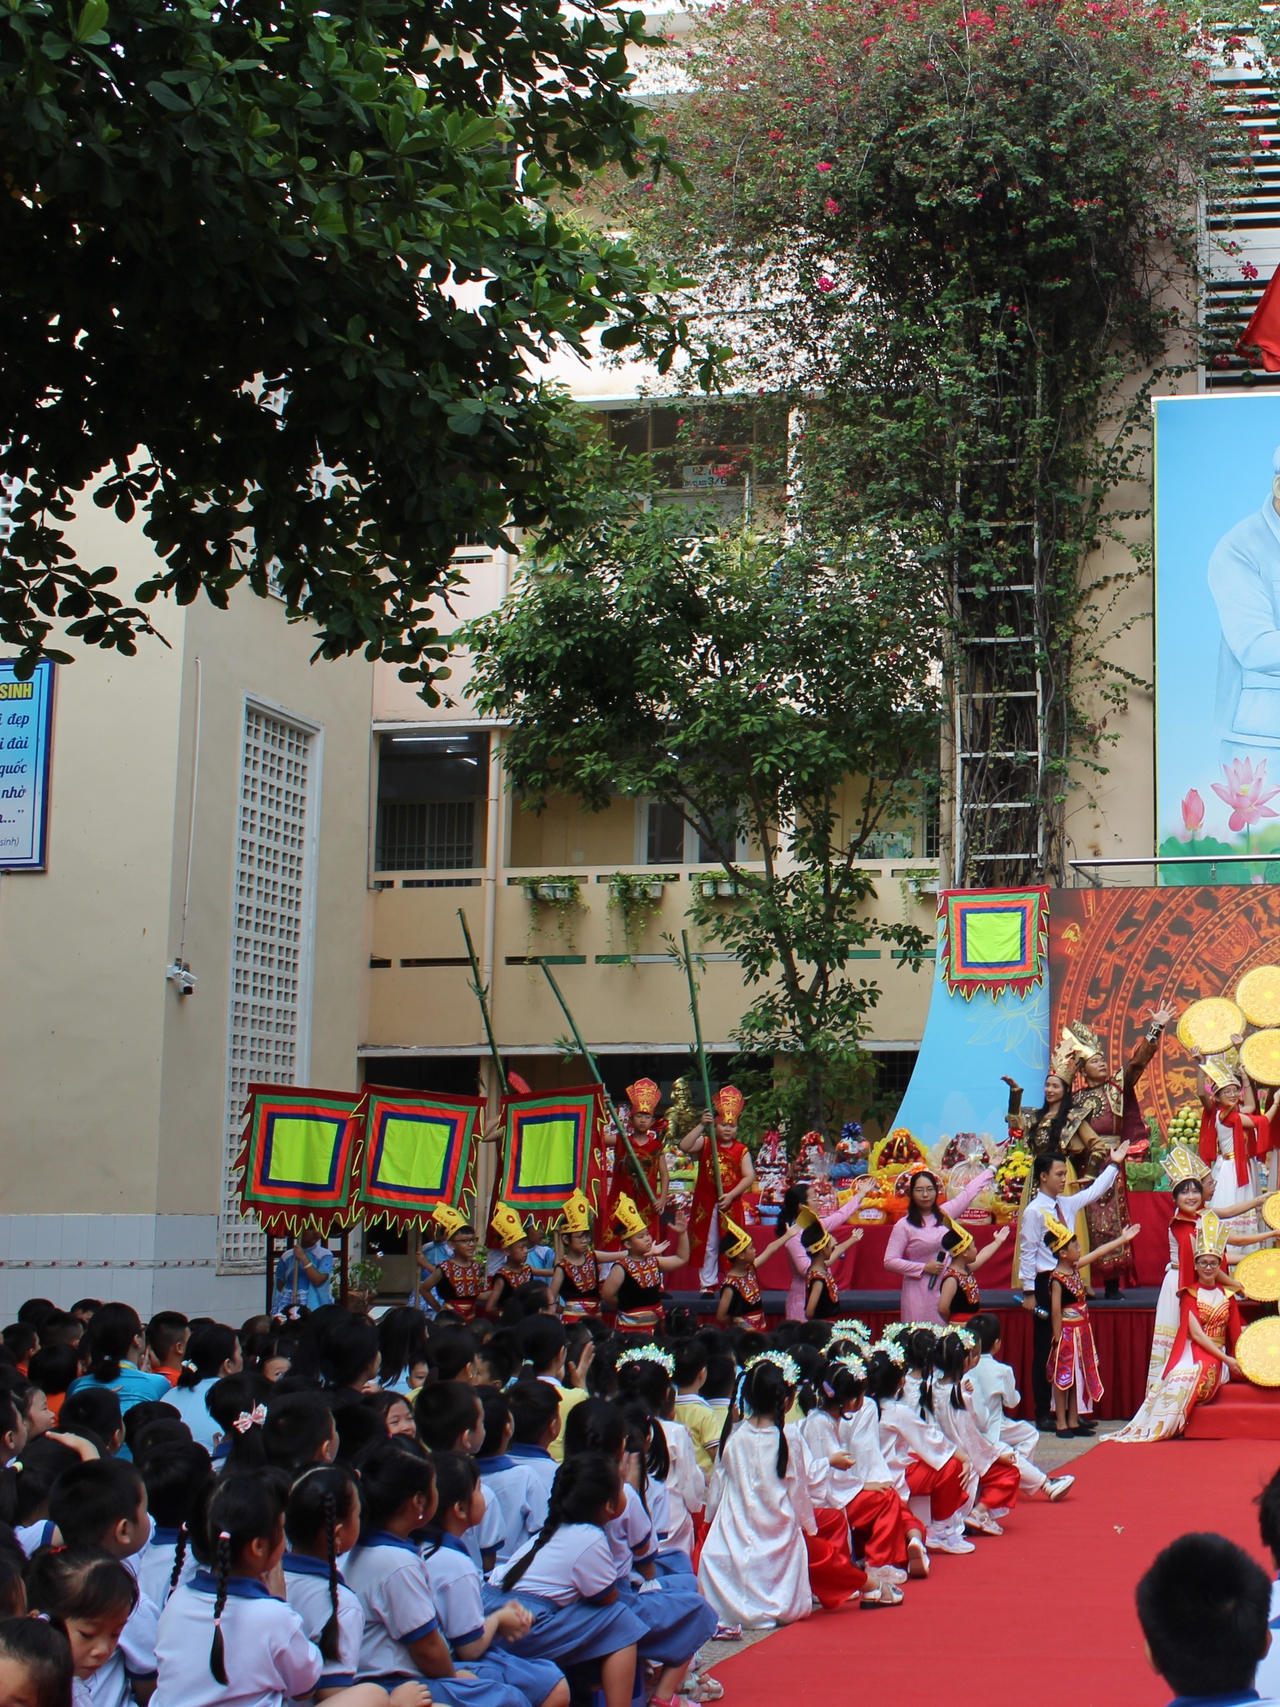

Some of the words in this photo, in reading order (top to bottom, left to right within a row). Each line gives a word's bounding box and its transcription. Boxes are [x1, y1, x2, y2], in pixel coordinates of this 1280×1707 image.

[0, 683, 32, 699] SINH
[7, 712, 30, 727] đẹp
[7, 736, 29, 750] đài
[0, 758, 27, 778] quốc
[1, 785, 27, 798] nhờ
